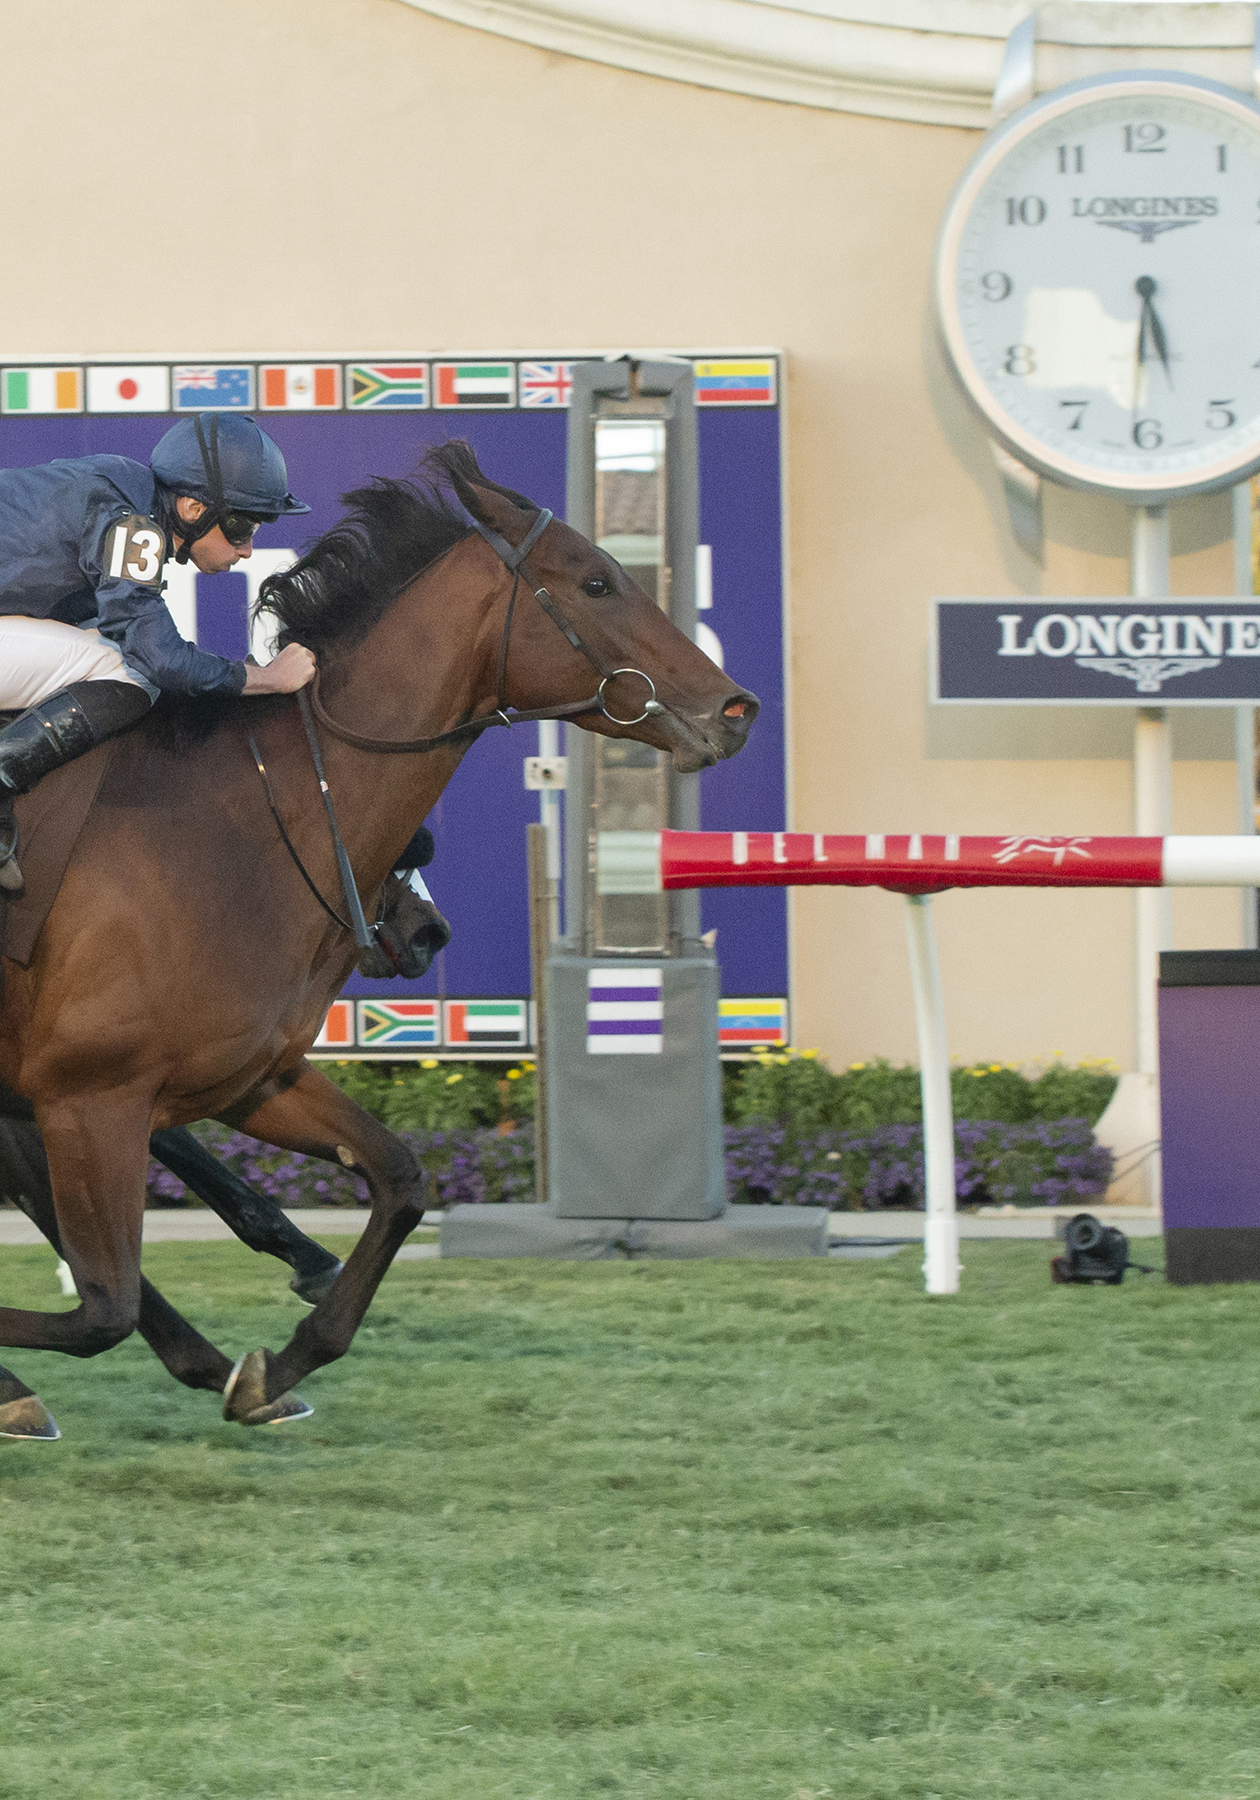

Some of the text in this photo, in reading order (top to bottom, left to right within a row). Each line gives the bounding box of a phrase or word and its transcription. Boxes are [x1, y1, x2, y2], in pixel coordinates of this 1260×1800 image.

[1122, 122, 1168, 153] 12
[1056, 144, 1086, 175] 11
[1216, 143, 1228, 174] 1
[1005, 195, 1048, 227] 10
[1072, 196, 1220, 218] LONGINES
[980, 270, 1014, 302] 9
[1004, 344, 1038, 376] 8
[1059, 400, 1090, 431] 7
[1205, 399, 1237, 430] 5
[1131, 418, 1165, 451] 6
[109, 526, 162, 582] 13
